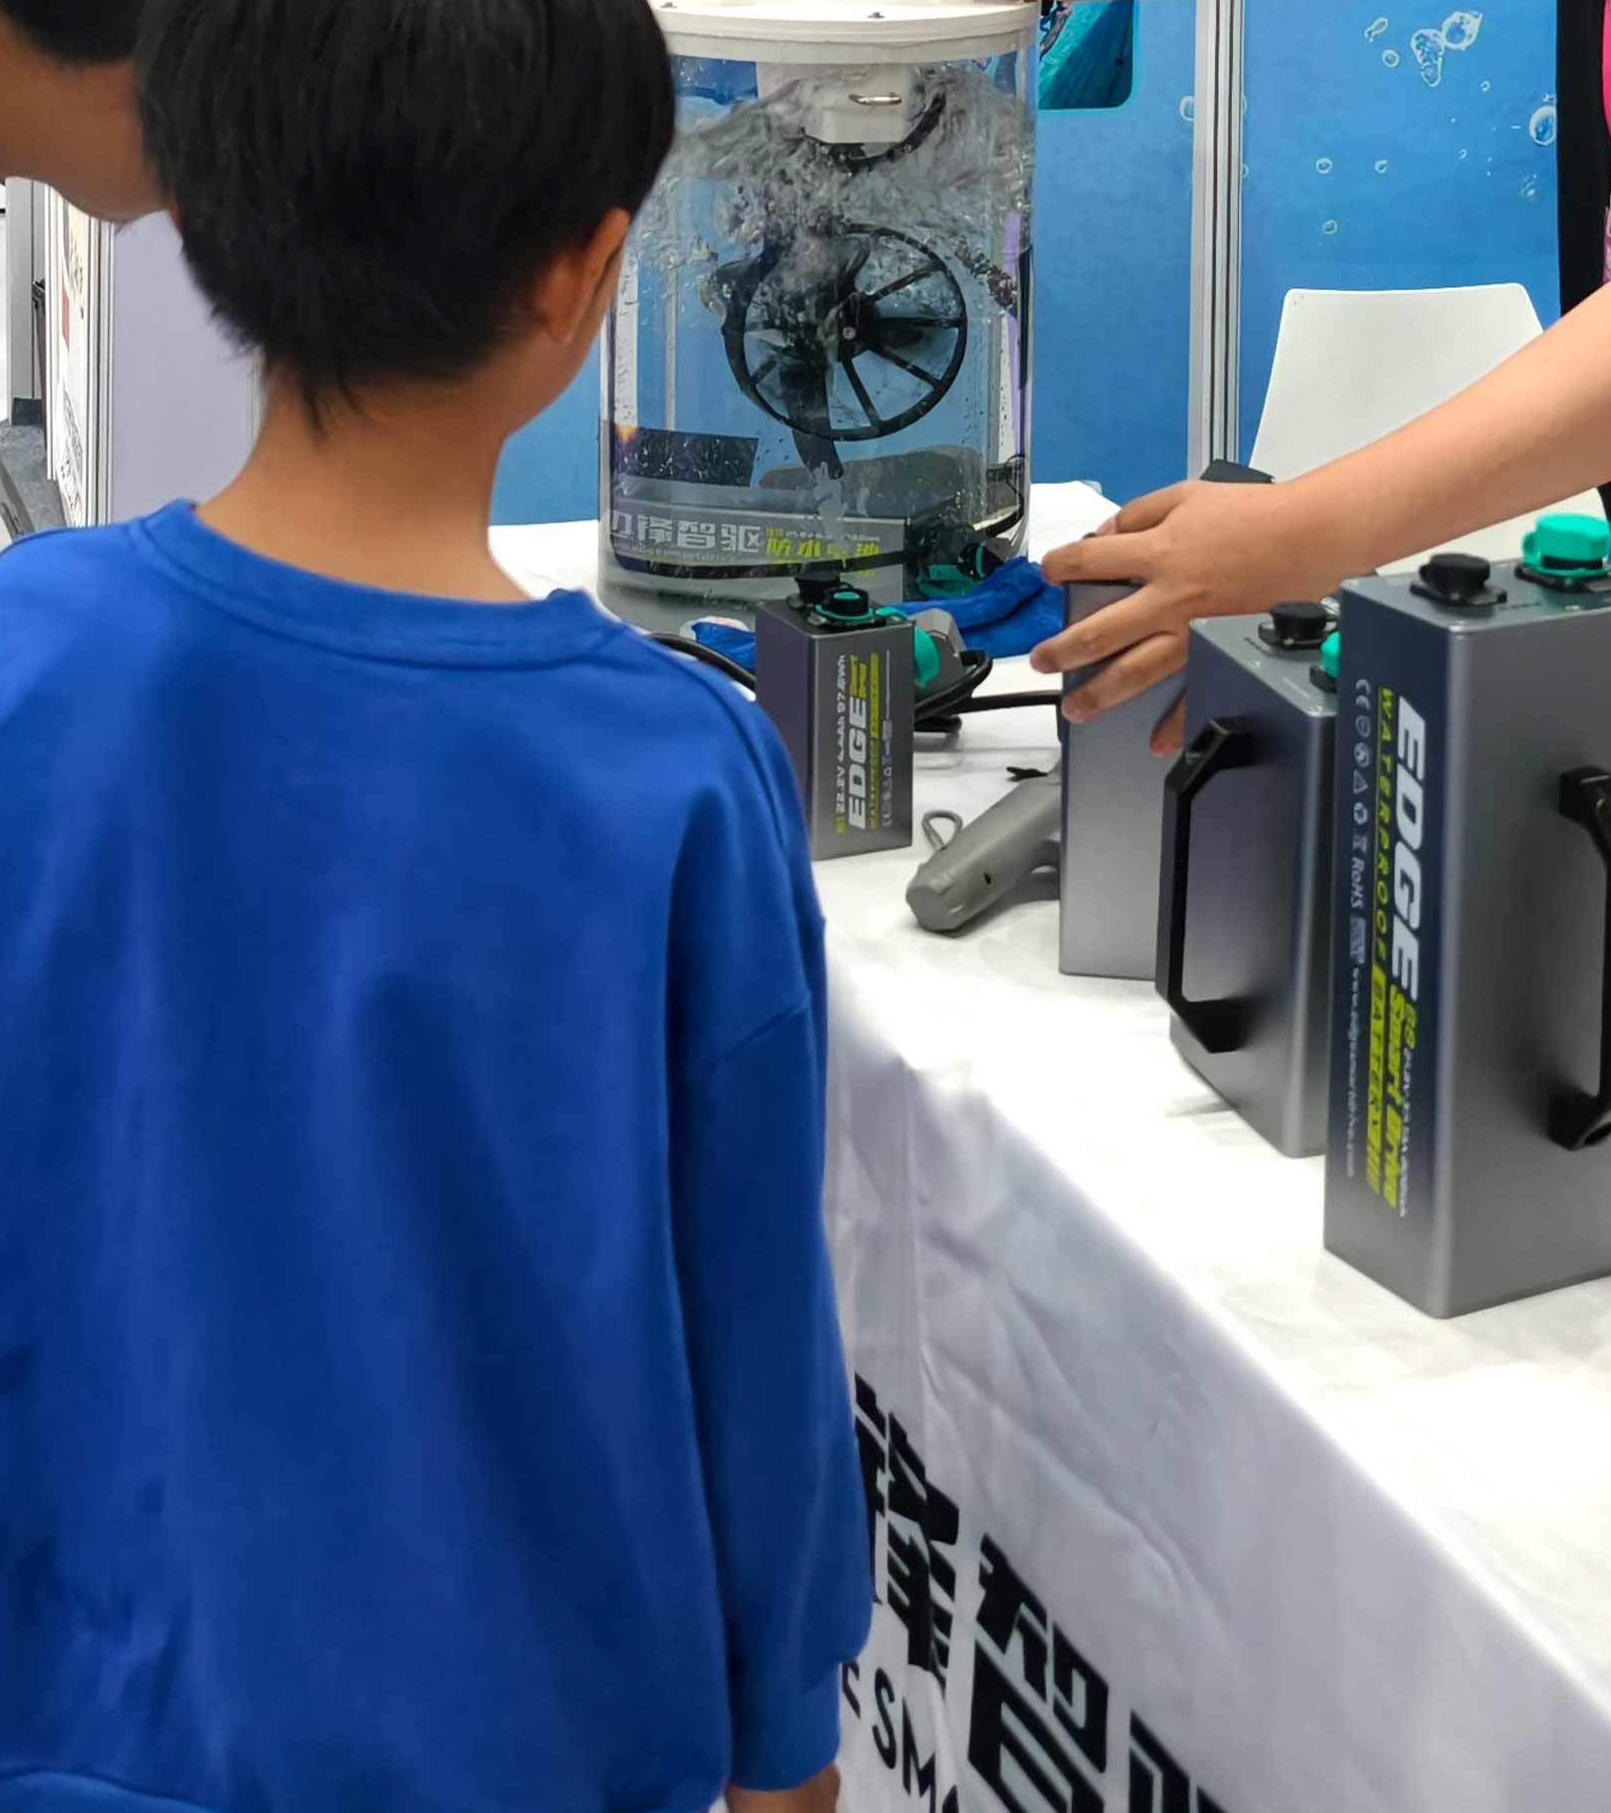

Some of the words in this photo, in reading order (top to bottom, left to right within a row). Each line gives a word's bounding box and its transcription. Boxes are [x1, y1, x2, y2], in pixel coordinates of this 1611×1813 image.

[847, 695, 868, 830] EDGE
[1372, 685, 1394, 967] WATERPROOF
[1389, 693, 1426, 1001] EDGE
